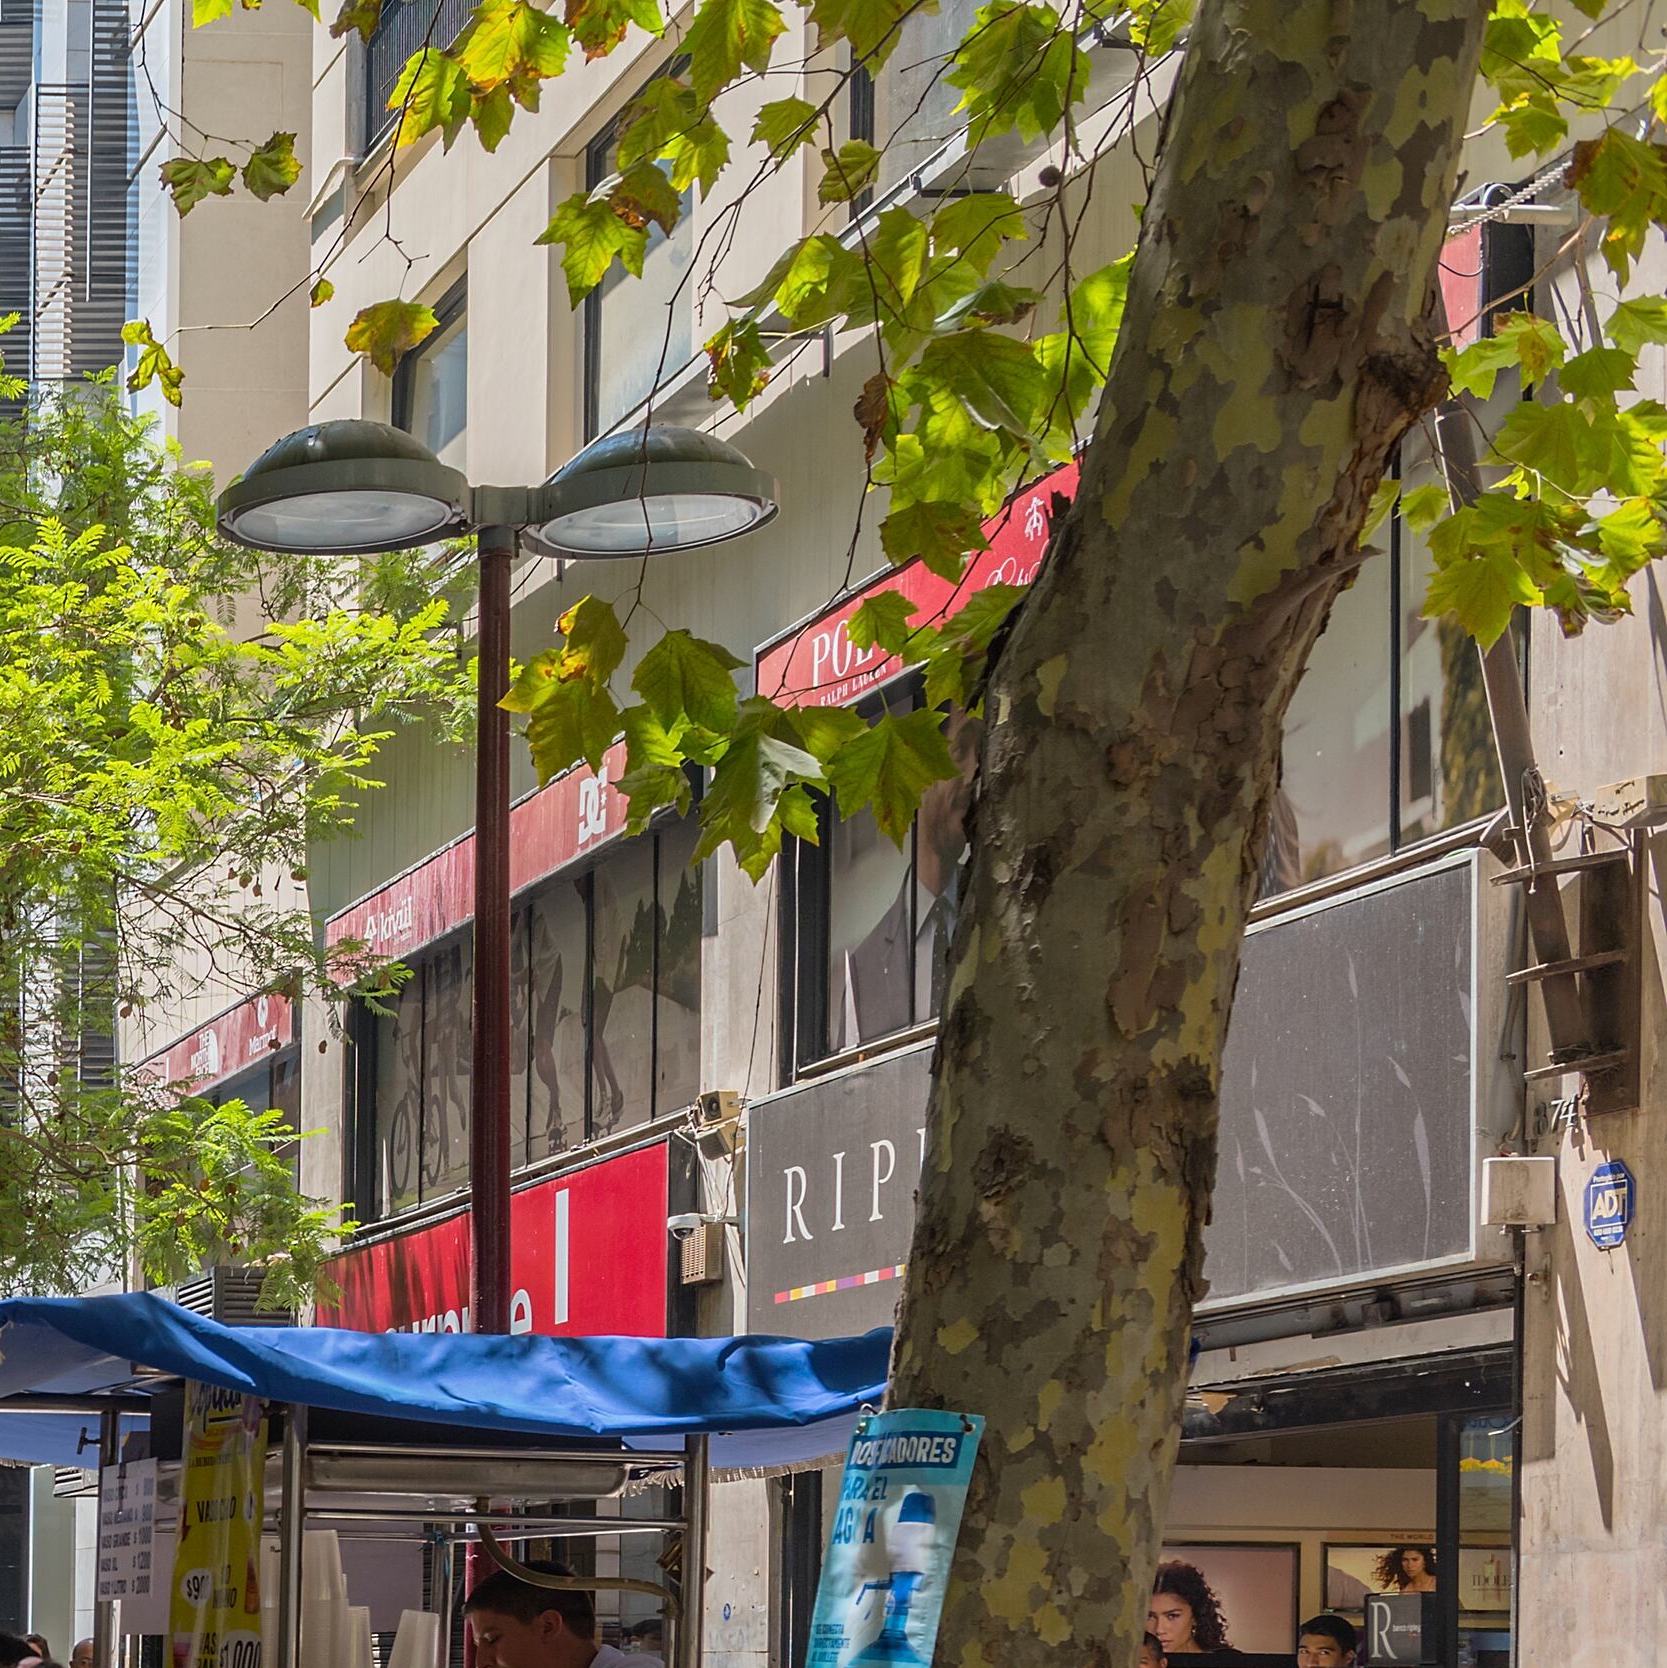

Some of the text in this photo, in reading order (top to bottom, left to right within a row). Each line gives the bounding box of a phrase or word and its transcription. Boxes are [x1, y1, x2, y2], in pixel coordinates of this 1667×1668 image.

[199, 1030, 210, 1046] THE
[1592, 1188, 1627, 1221] ADT
[871, 1476, 888, 1500] EL
[832, 1507, 876, 1545] AGA
